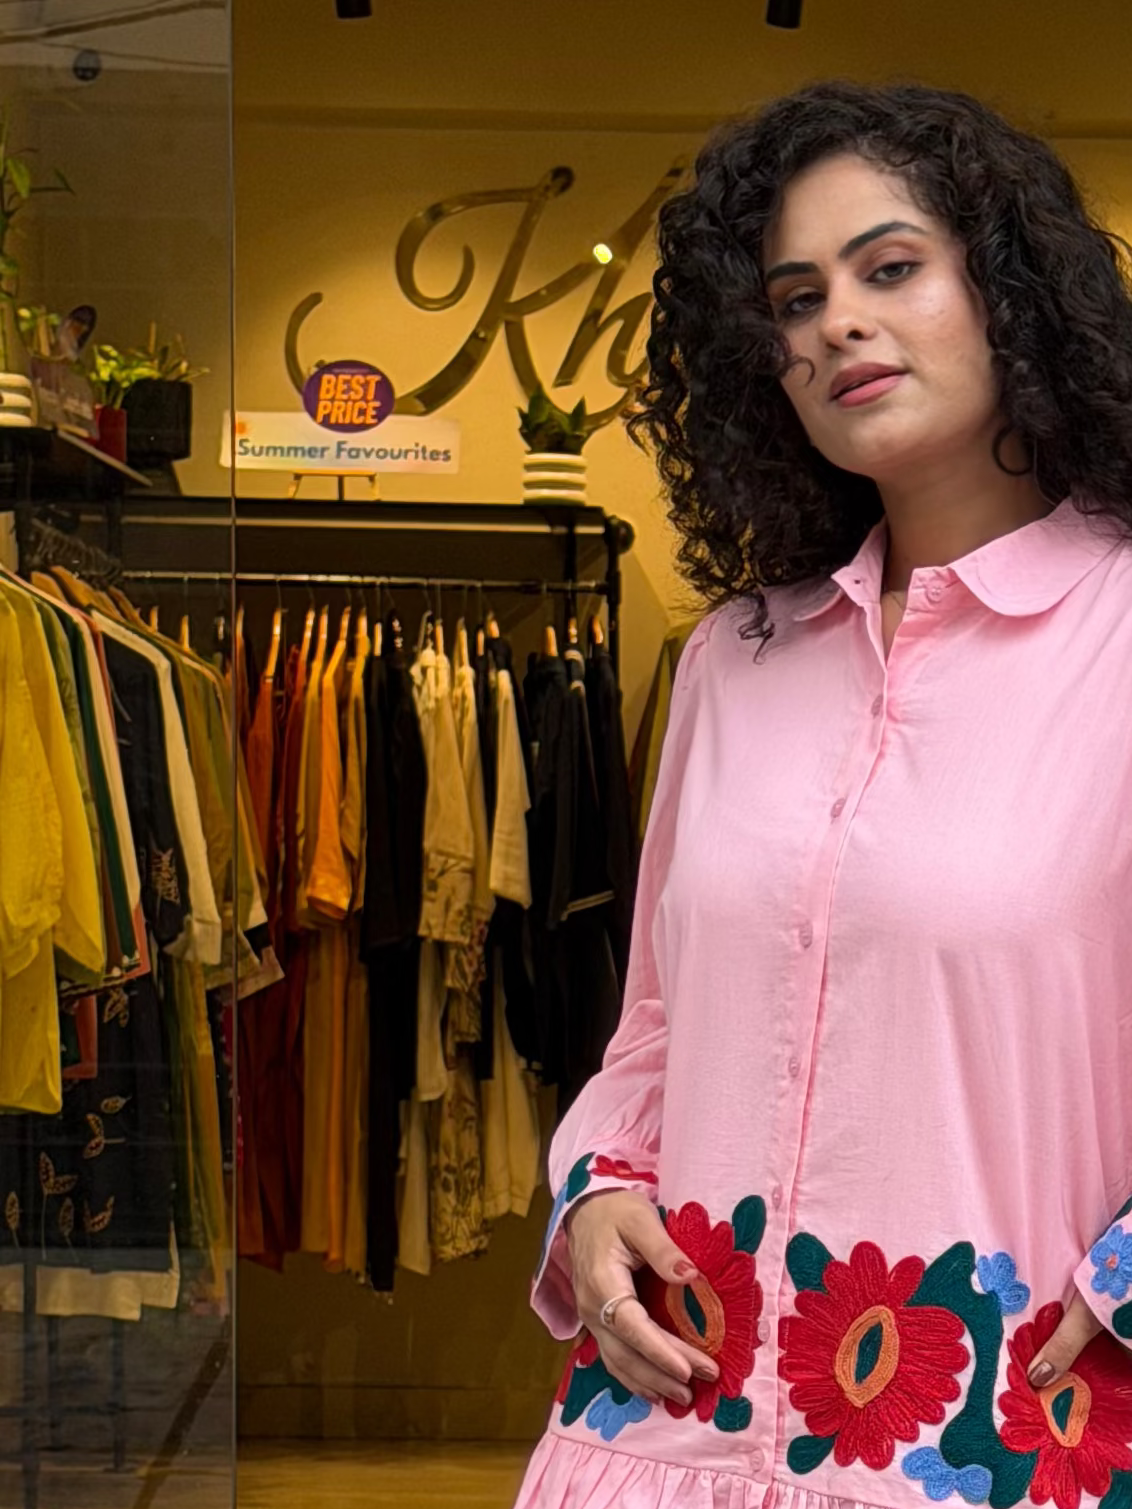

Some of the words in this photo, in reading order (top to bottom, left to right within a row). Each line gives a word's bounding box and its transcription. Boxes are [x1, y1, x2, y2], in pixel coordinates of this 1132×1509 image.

[319, 373, 382, 400] BEST
[315, 400, 381, 425] PRICE
[237, 437, 330, 459] Summer
[335, 440, 452, 462] Favourites
